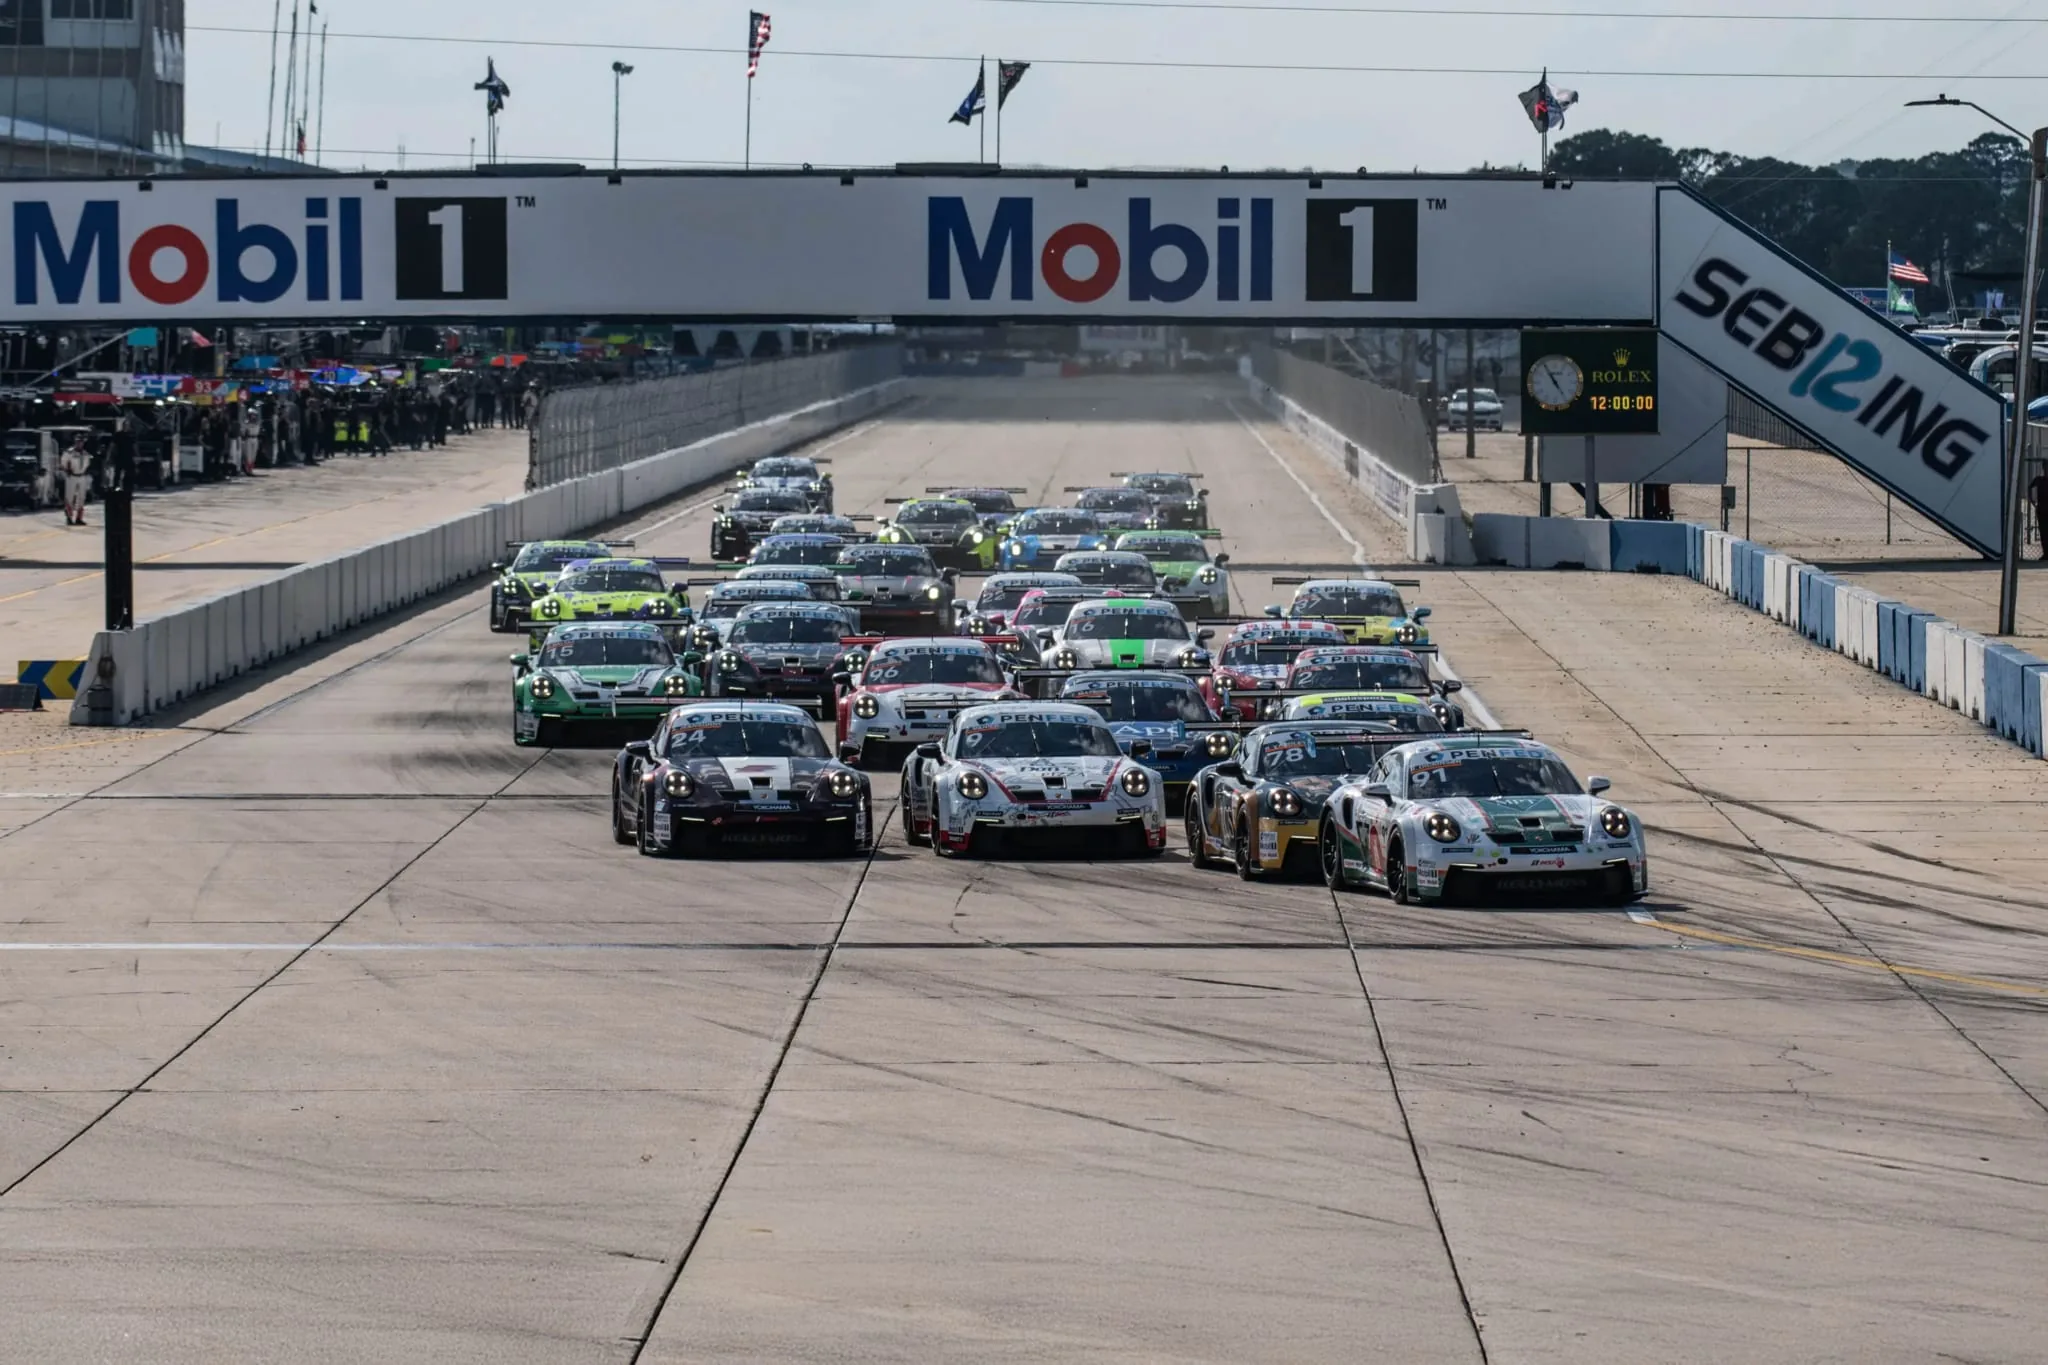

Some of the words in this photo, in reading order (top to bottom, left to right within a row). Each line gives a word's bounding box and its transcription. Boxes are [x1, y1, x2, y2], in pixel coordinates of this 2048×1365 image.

[13, 197, 363, 305] Mobil
[428, 204, 465, 293] 1
[927, 196, 1273, 303] Mobil
[1340, 205, 1375, 295] 1
[1592, 370, 1653, 384] ROLEX
[195, 380, 212, 393] 93
[1590, 395, 1654, 411] 12:00:00
[1071, 621, 1096, 635] 16
[578, 631, 650, 640] PENFED
[547, 645, 575, 660] 15
[904, 647, 979, 656] PENFED
[1331, 655, 1408, 664] PENFED
[870, 666, 900, 682] 96
[1331, 703, 1418, 713] PENFED
[710, 713, 799, 723] PENFED
[1000, 714, 1089, 724] PENFED
[671, 730, 707, 748] 24
[966, 732, 983, 748] 9
[1265, 747, 1304, 767] 78
[1450, 749, 1544, 760] PENFED
[1411, 767, 1447, 788] 91
